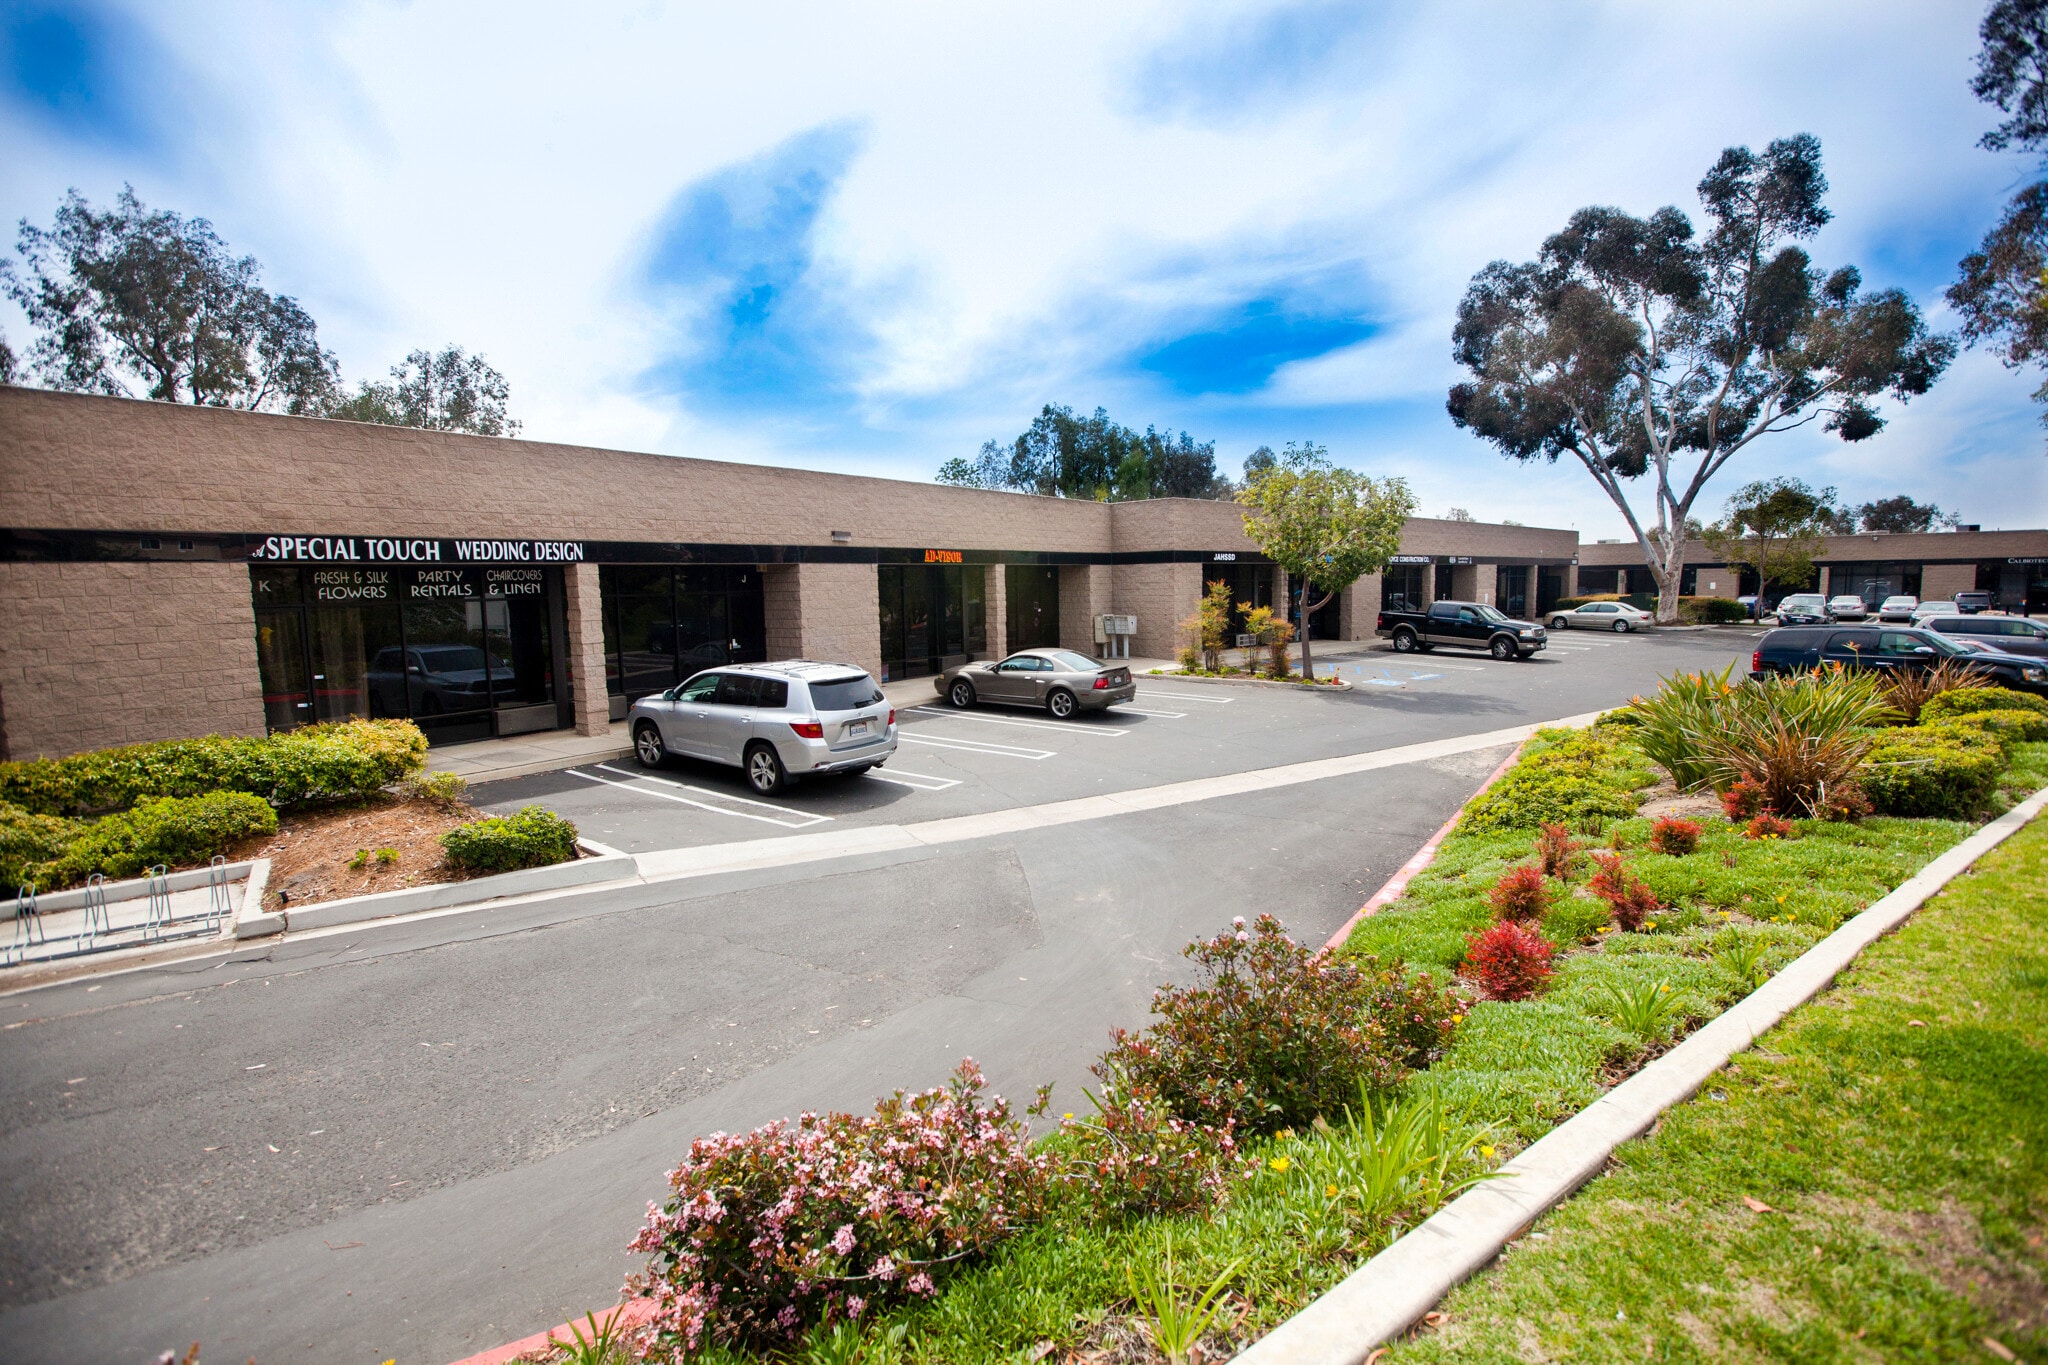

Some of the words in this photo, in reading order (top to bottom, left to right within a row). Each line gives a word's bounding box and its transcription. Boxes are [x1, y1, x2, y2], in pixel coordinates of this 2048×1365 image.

[252, 544, 266, 558] A
[266, 536, 361, 560] SPECIAL
[364, 538, 440, 561] TOUCH
[455, 540, 530, 561] WEDDING
[534, 542, 584, 561] DESIGN
[924, 549, 963, 563] AD-VISOR
[314, 571, 350, 585] FRESH
[354, 571, 363, 584] &
[366, 571, 389, 584] SILK
[418, 570, 463, 582] PARTY
[486, 569, 543, 582] CHAIRCOVERS
[741, 574, 747, 583] J
[259, 580, 272, 592] K
[318, 585, 388, 600] FLOWERS
[411, 583, 473, 597] RENTALS
[489, 583, 500, 595] &
[504, 582, 541, 595] LINEN
